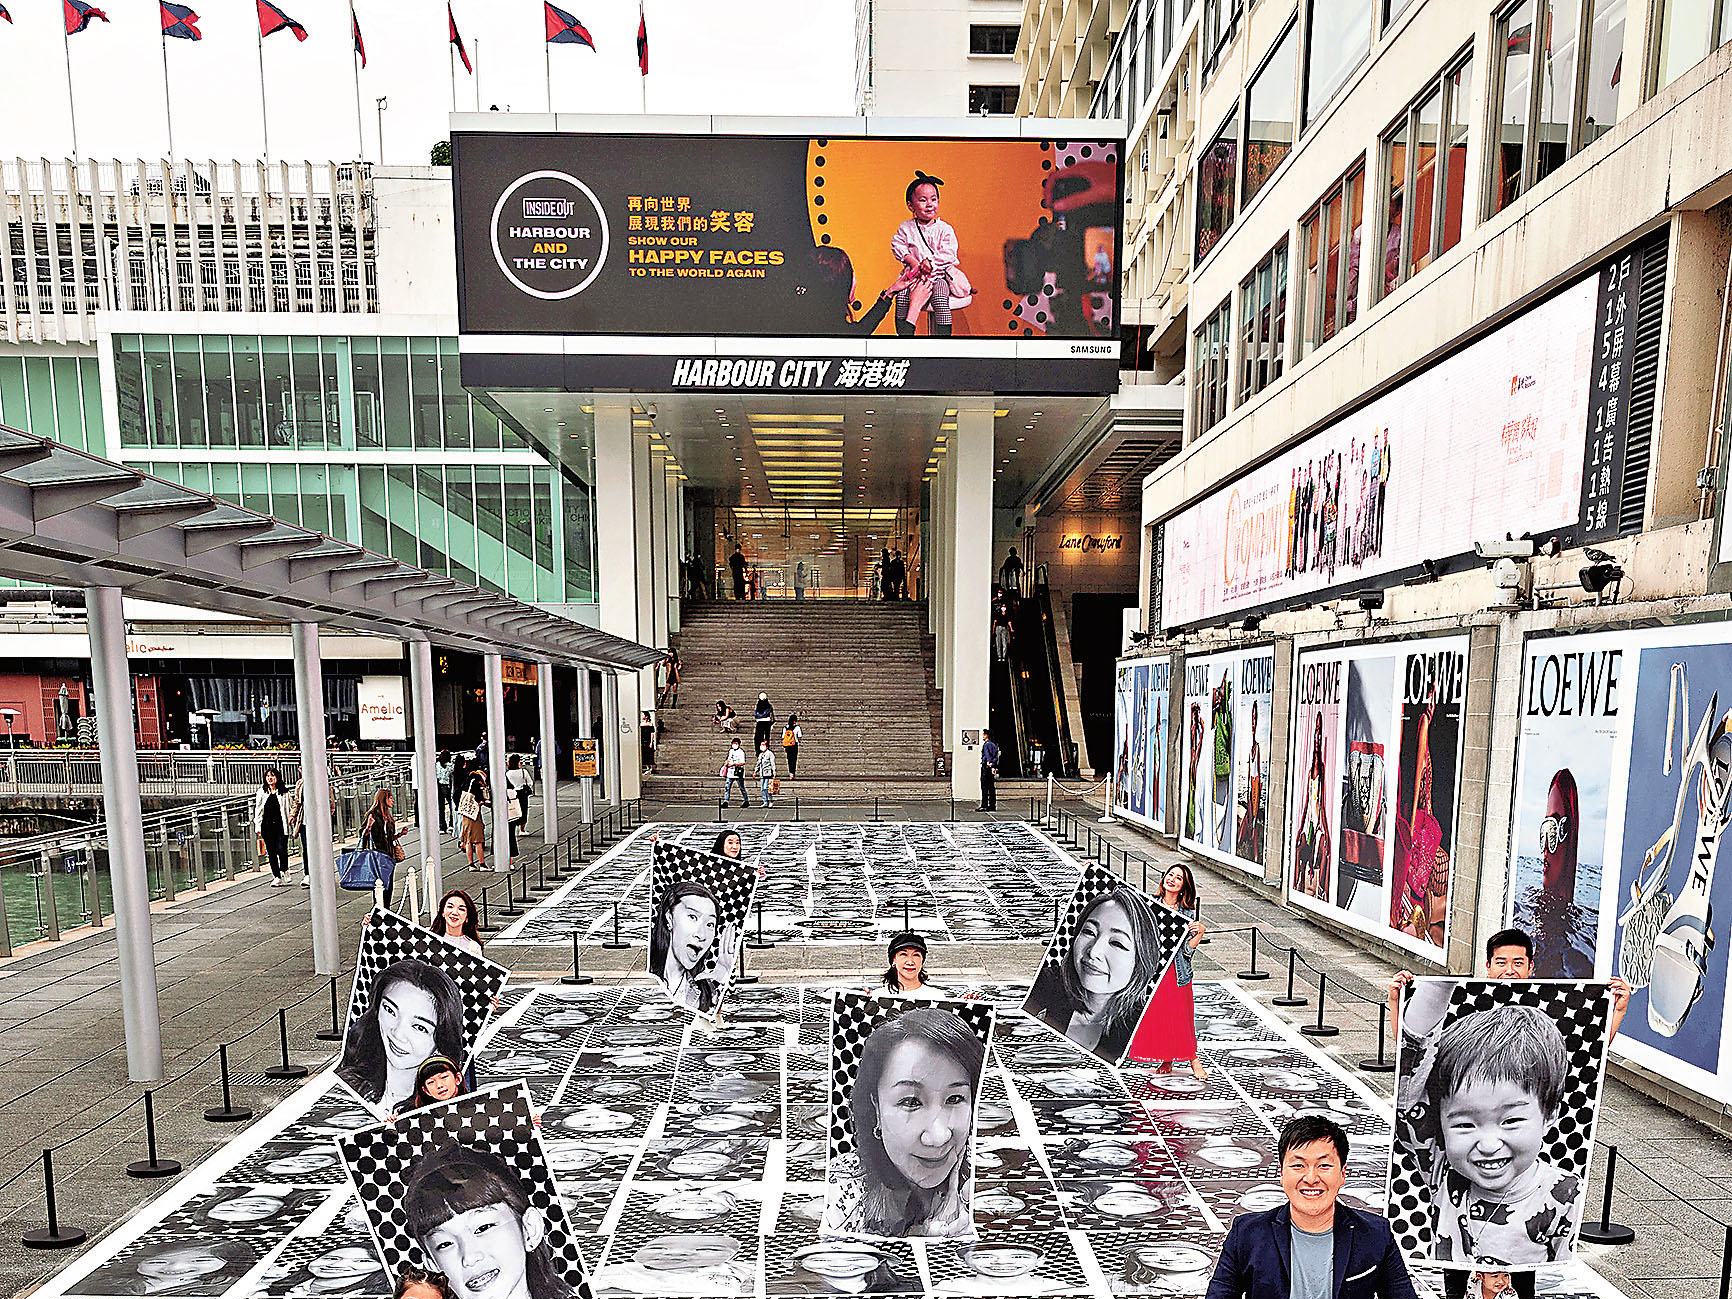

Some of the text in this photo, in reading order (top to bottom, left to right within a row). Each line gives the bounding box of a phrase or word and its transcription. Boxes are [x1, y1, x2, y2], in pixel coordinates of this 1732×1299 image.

[525, 200, 555, 217] INSIDE
[627, 195, 692, 213] 再向世界
[627, 210, 756, 234] 展現我們的笑容
[508, 226, 591, 240] HARBOUR
[627, 236, 699, 247] SHOW OUR
[532, 242, 569, 255] AND
[628, 249, 785, 266] HAPPY FACES
[512, 256, 590, 271] THE CITY
[628, 267, 766, 279] TO THE WORLD AGAIN
[1069, 344, 1113, 354] SAMSUNG
[671, 358, 906, 389] HARBOUR CITY 海港城
[1059, 533, 1123, 553] Lane Crawford
[1151, 662, 1170, 692] LOEWE
[1187, 663, 1210, 697] LOEWE
[1241, 656, 1273, 695] LOEWE
[1300, 660, 1343, 706] LOEWE
[1402, 651, 1464, 705] LOEWE
[1526, 649, 1624, 717] LOEWE
[361, 702, 404, 715] Amelic
